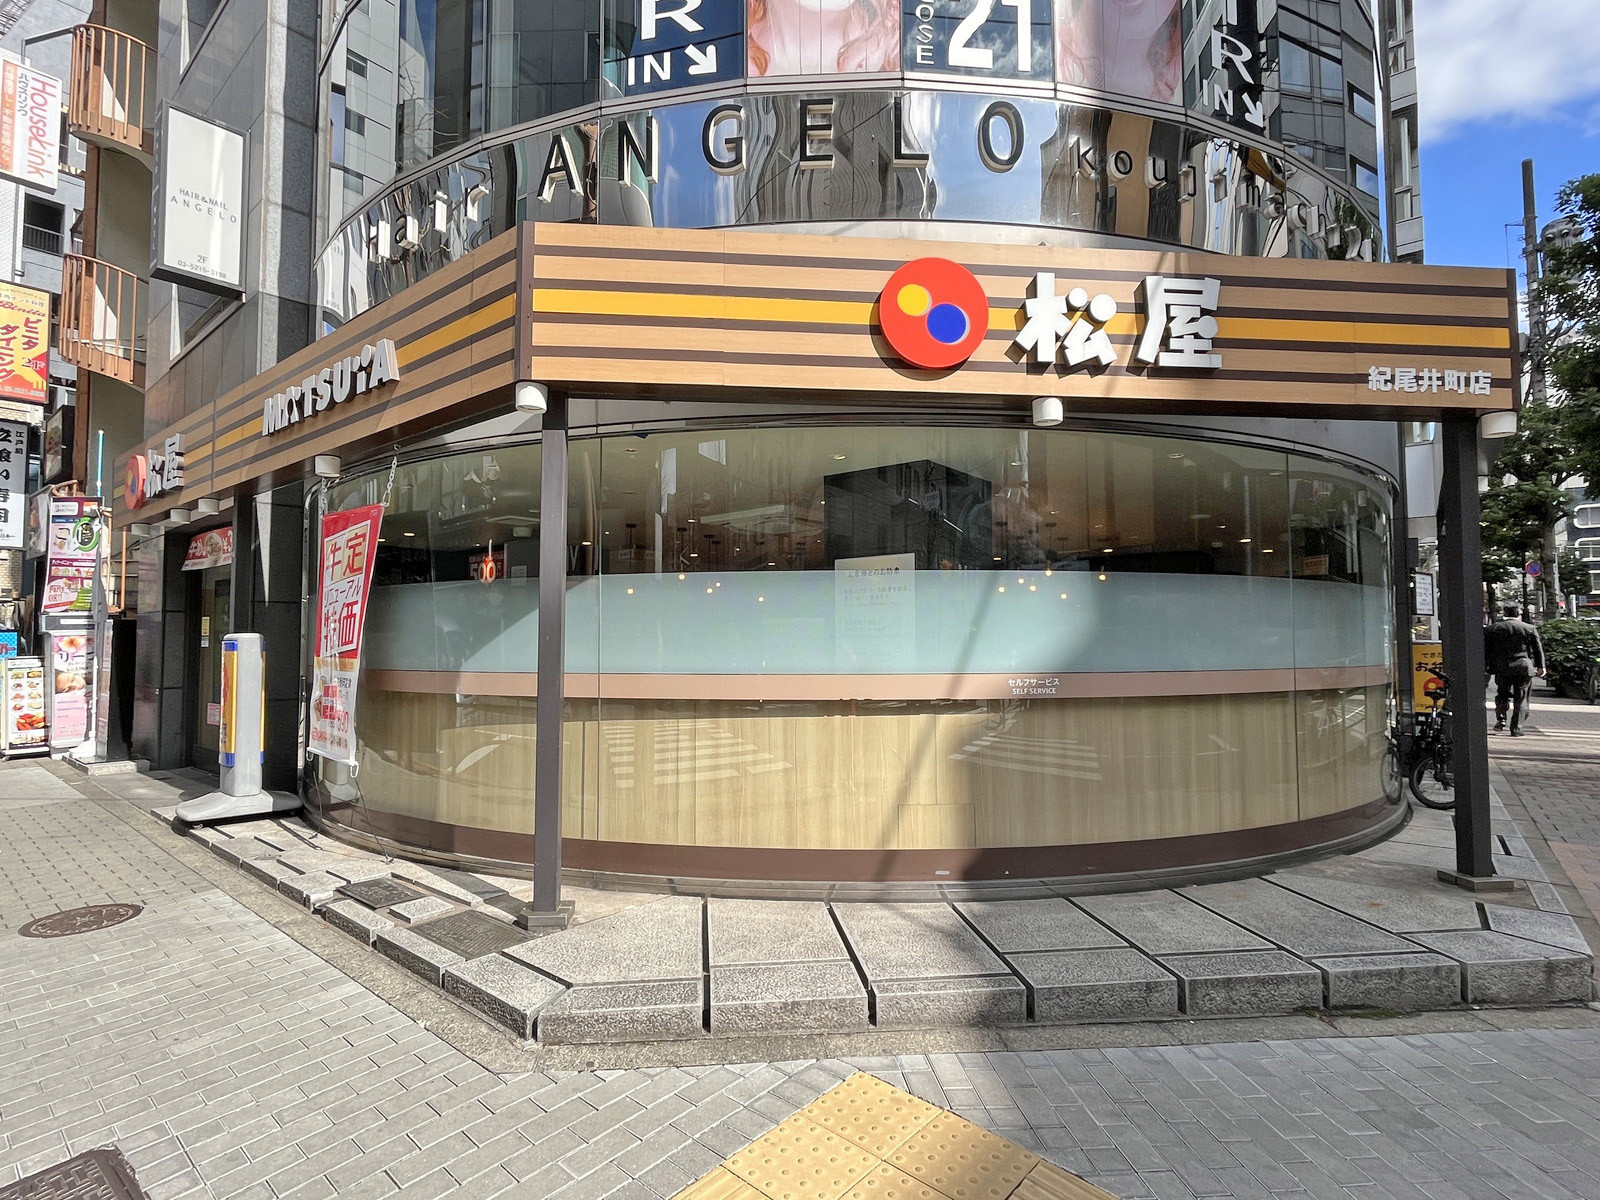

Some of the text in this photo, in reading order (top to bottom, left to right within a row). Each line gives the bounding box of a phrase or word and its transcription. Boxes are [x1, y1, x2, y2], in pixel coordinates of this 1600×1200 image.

[628, 51, 671, 86] IN
[1203, 79, 1234, 116] IN
[536, 98, 1025, 204] ANGELO
[170, 195, 237, 224] ANGELO
[197, 254, 208, 264] 2F
[1014, 271, 1223, 368] 松屋
[21, 357, 46, 371] 2F
[1367, 365, 1492, 396] 紀尾井町店
[143, 432, 184, 498] 松屋
[1007, 677, 1060, 687] セルフサービス
[1012, 687, 1057, 695] SELF SERVICE
